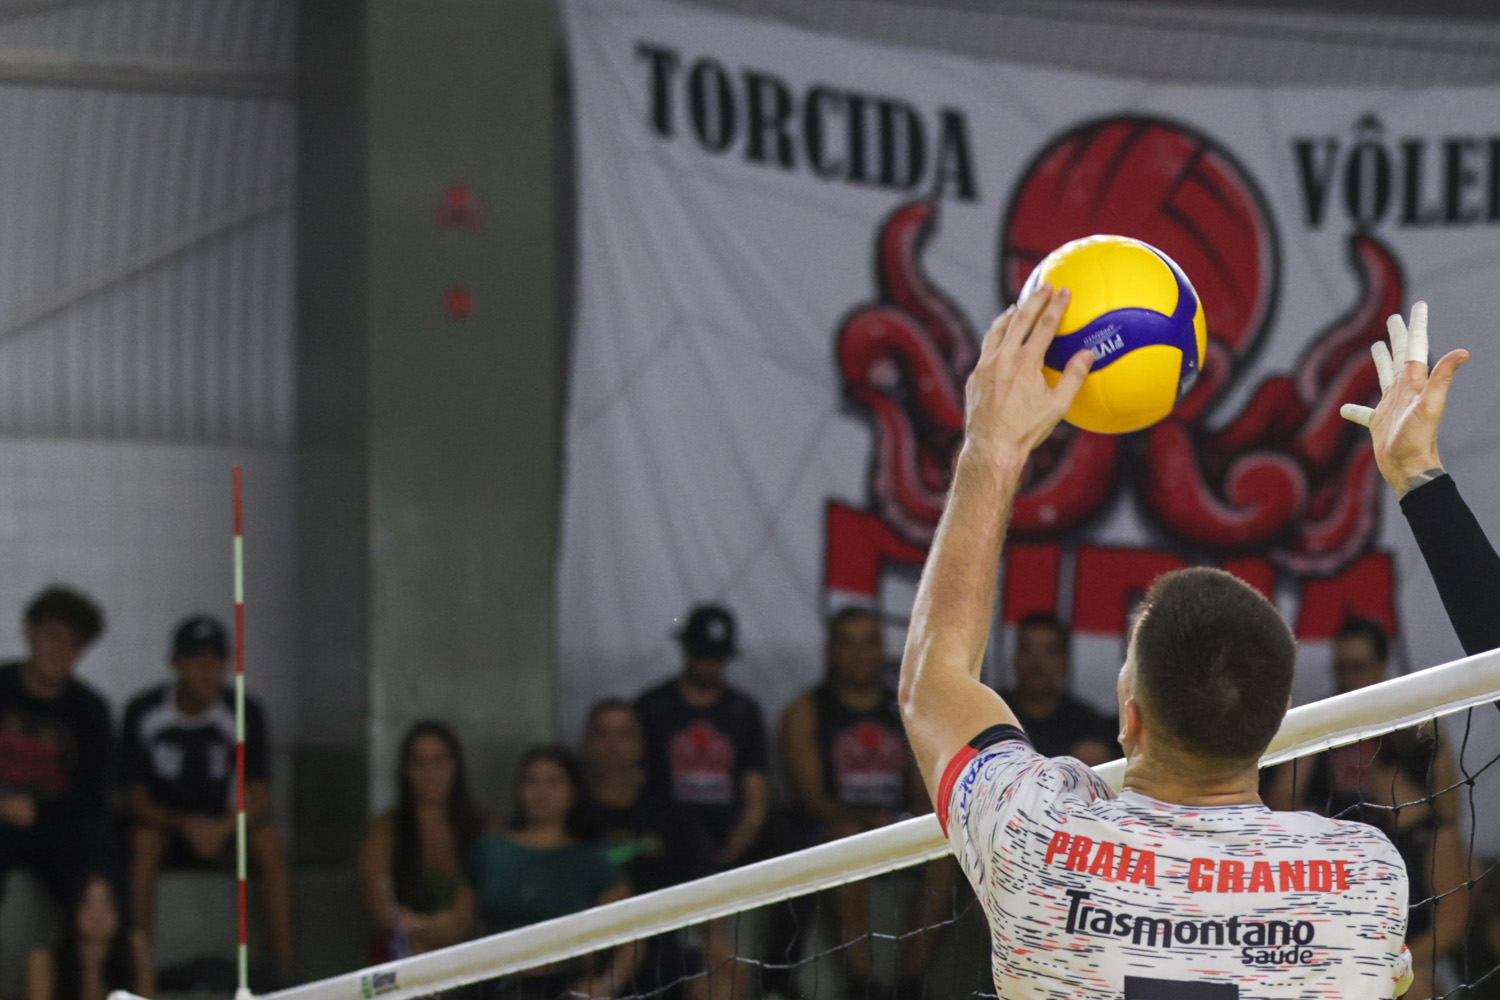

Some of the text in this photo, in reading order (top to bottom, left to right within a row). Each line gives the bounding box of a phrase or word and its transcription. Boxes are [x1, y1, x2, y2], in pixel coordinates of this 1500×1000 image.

[634, 38, 979, 204] TORCIDA
[1044, 830, 1351, 893] PRAIA GRANDE
[1065, 888, 1315, 948] Trasmontano
[1241, 945, 1314, 965] Saúde
